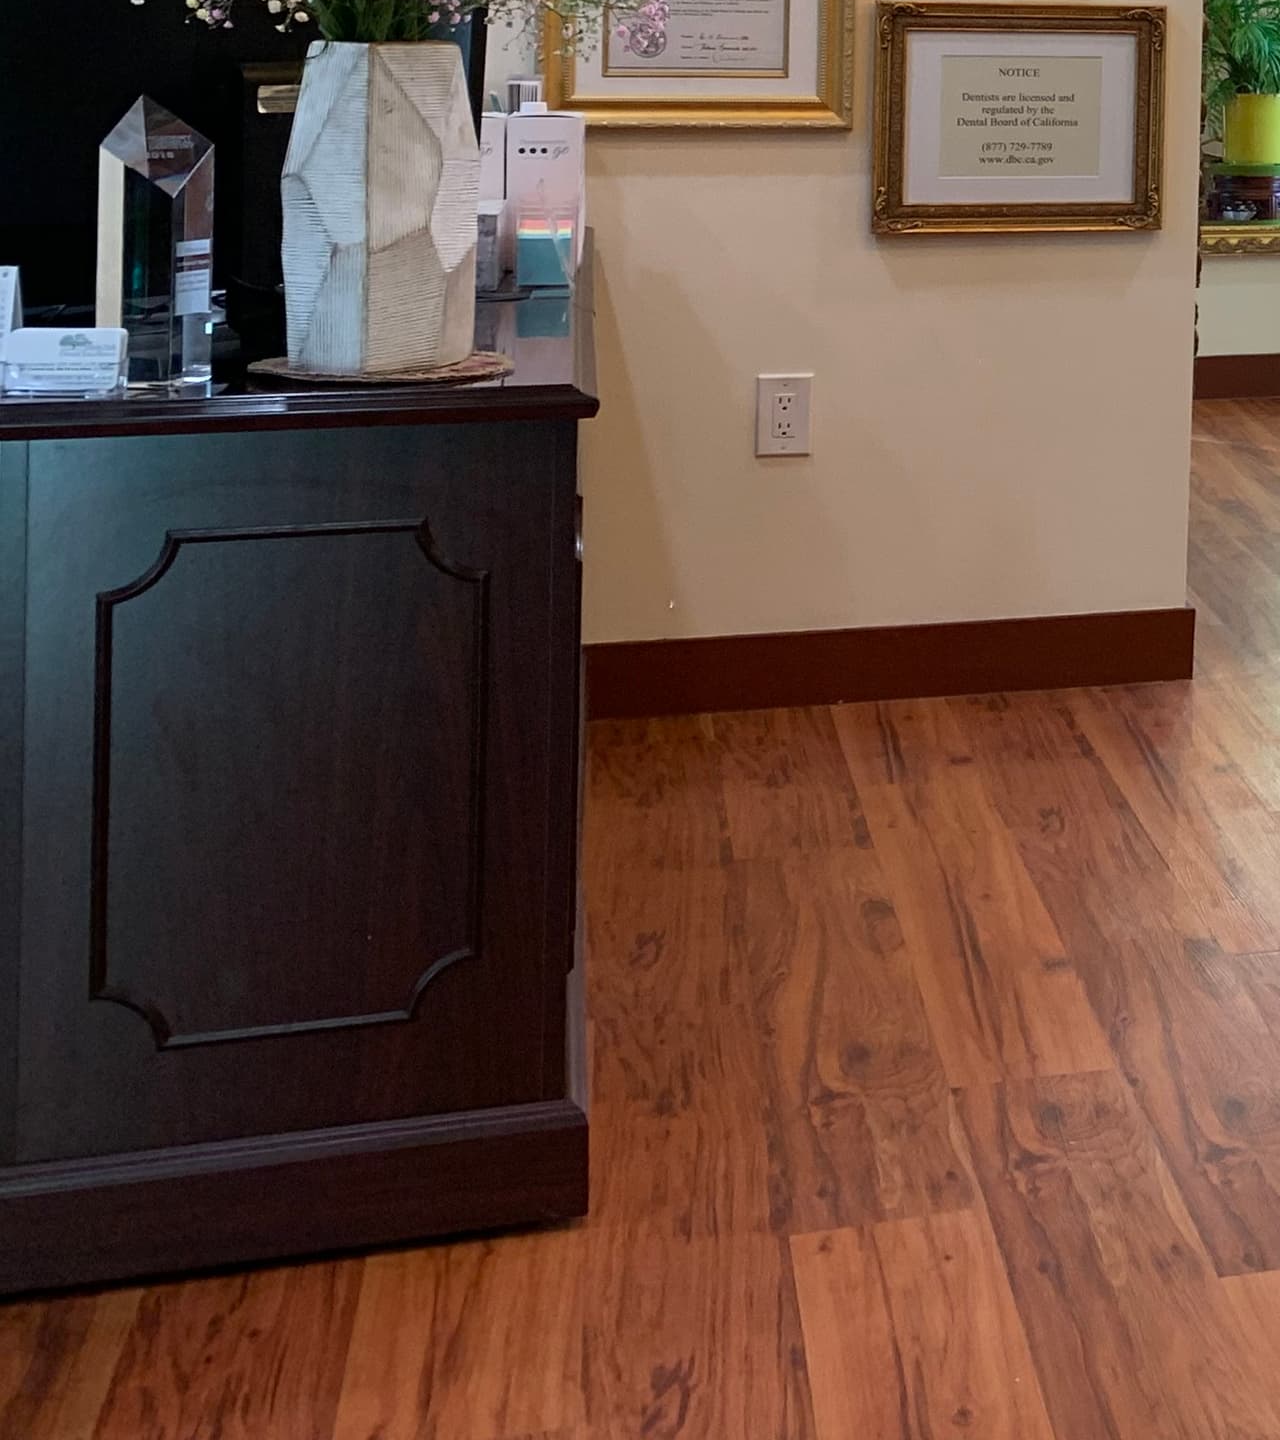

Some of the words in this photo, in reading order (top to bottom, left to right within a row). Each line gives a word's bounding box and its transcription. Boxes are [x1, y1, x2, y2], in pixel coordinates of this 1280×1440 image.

[999, 68, 1040, 78] NOTICE
[962, 93, 999, 102] Dentists
[1019, 93, 1055, 103] licensed
[1059, 93, 1075, 103] and
[982, 105, 1024, 117] regulated
[1026, 105, 1038, 117] by
[1041, 105, 1055, 114] the
[957, 117, 987, 127] Dental
[990, 117, 1018, 127] Board
[1020, 117, 1031, 127] of
[1032, 117, 1078, 127] California
[981, 142, 1007, 152] (877)
